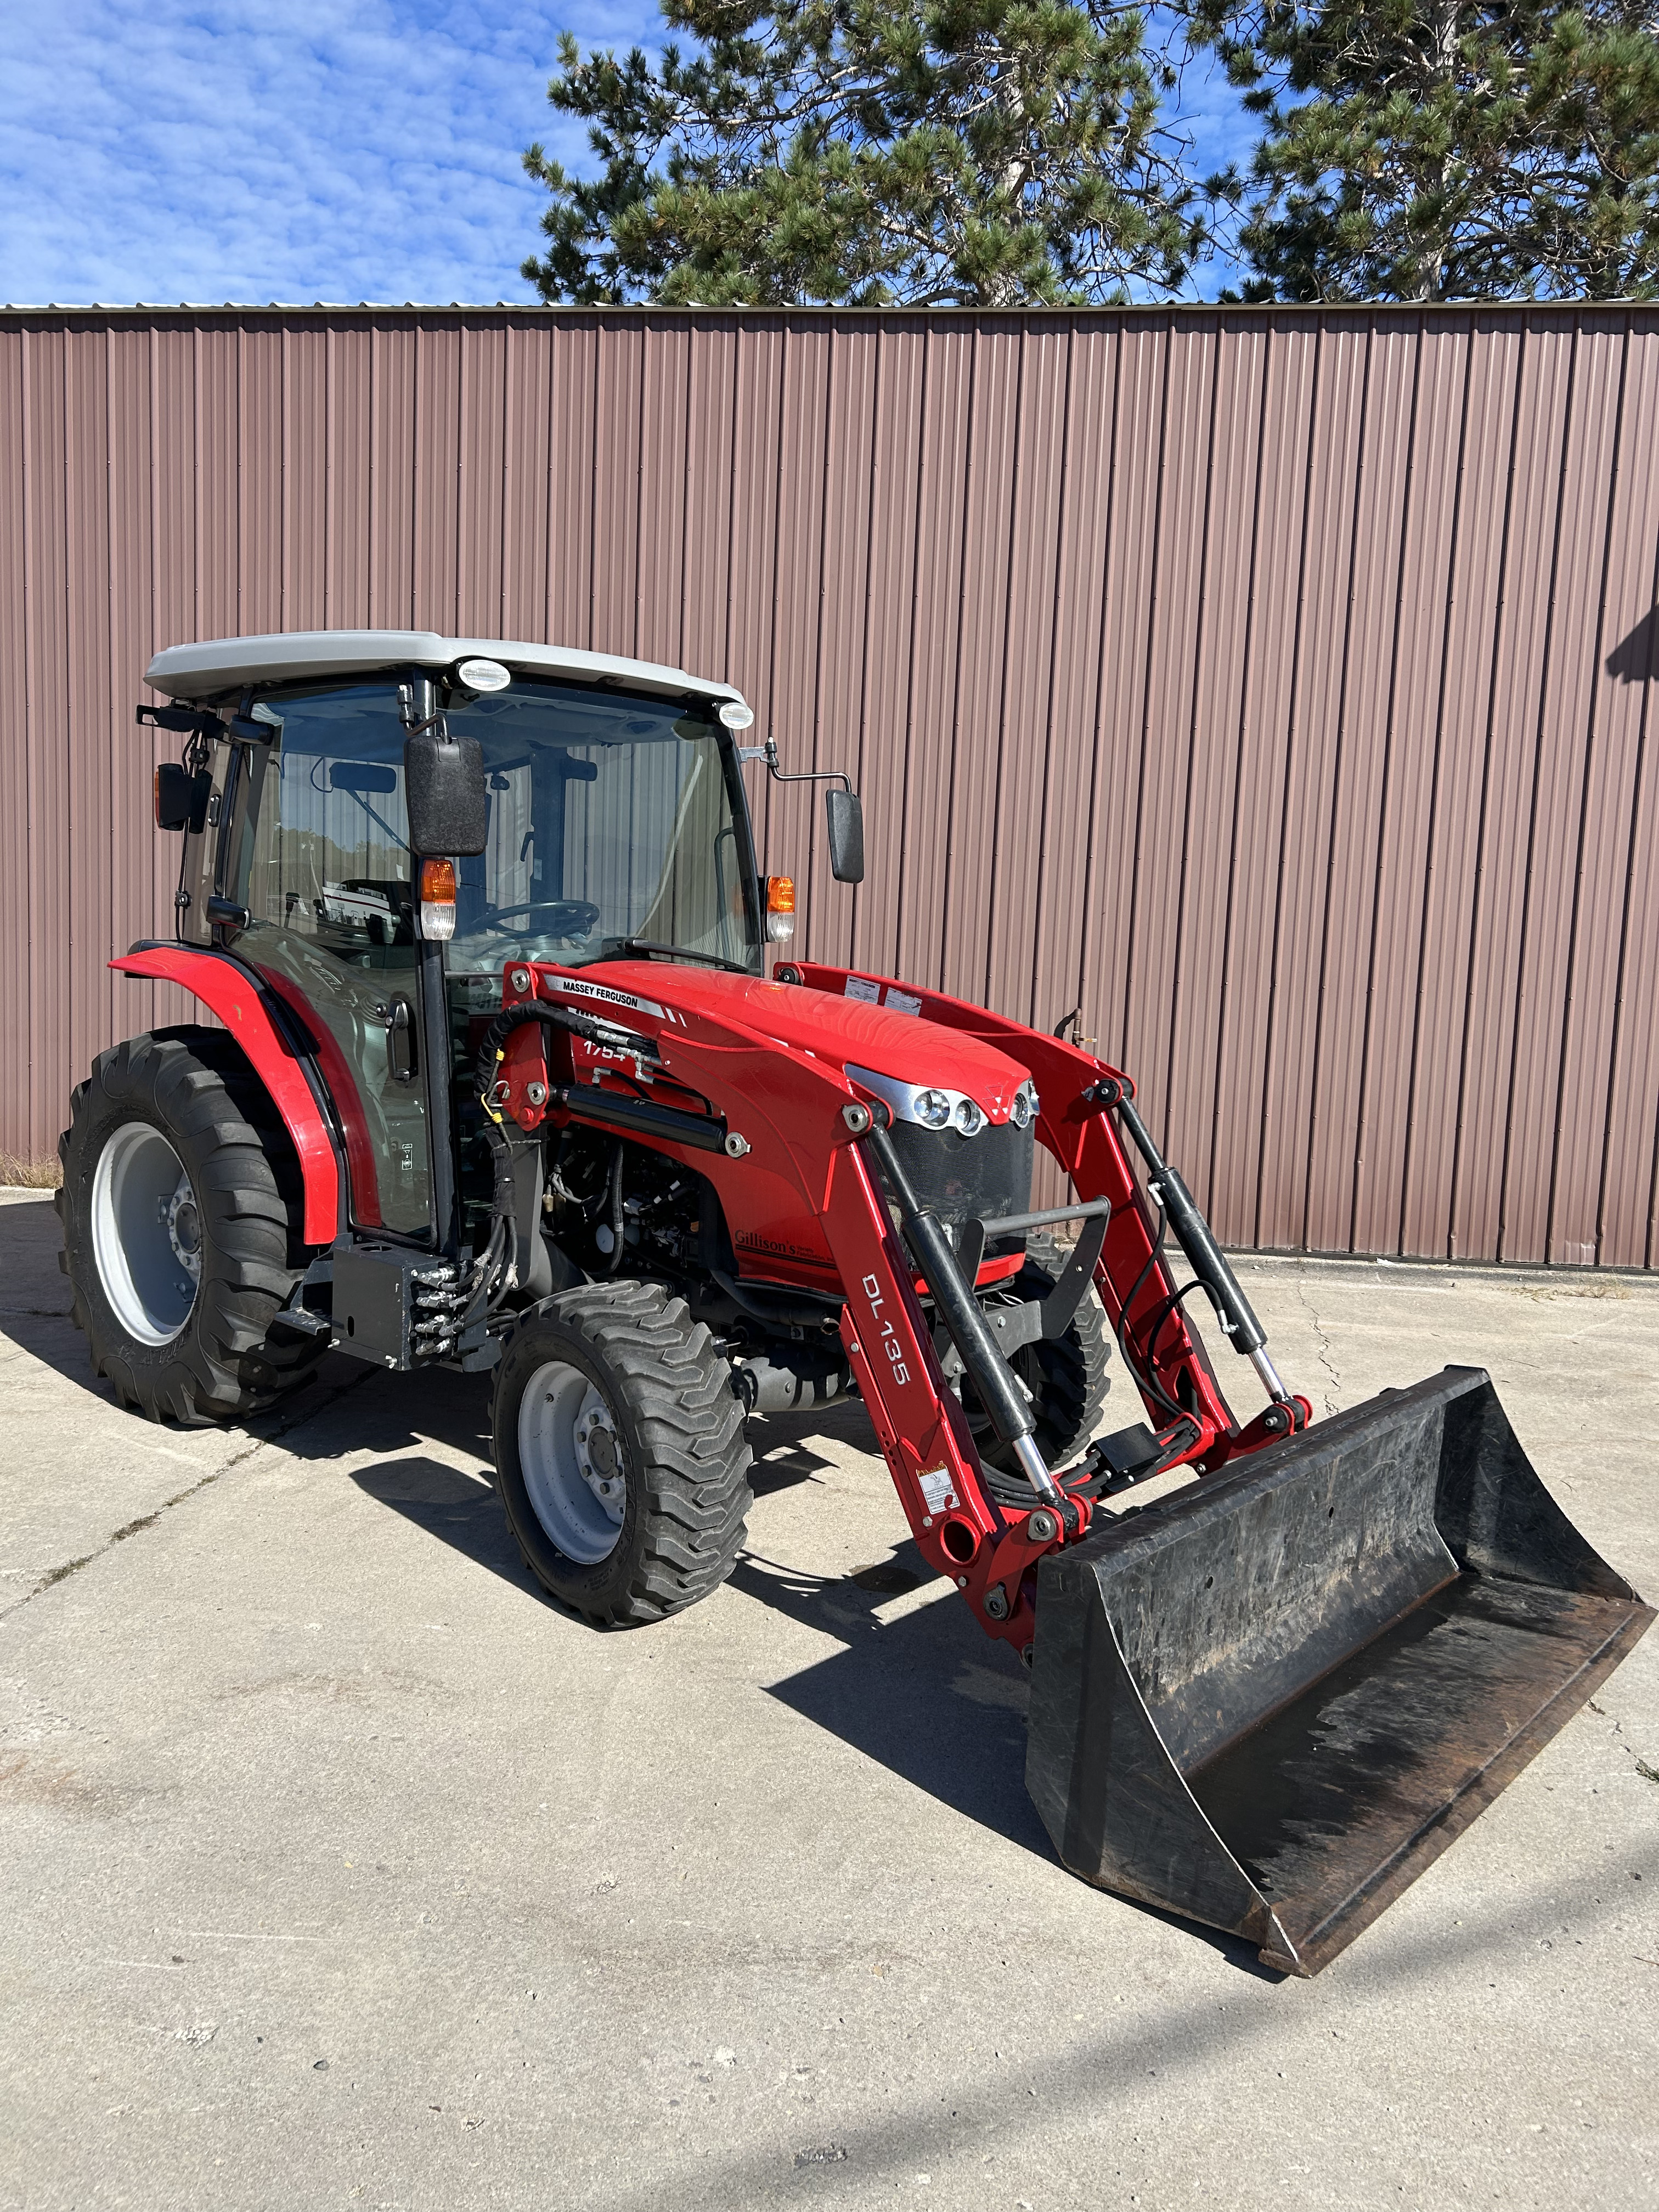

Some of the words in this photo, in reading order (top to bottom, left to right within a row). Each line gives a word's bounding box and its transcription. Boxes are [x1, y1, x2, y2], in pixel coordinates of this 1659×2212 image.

[563, 981, 594, 995] MASSEY
[596, 988, 638, 1007] FERGUSON
[735, 1229, 795, 1255] Gillison's
